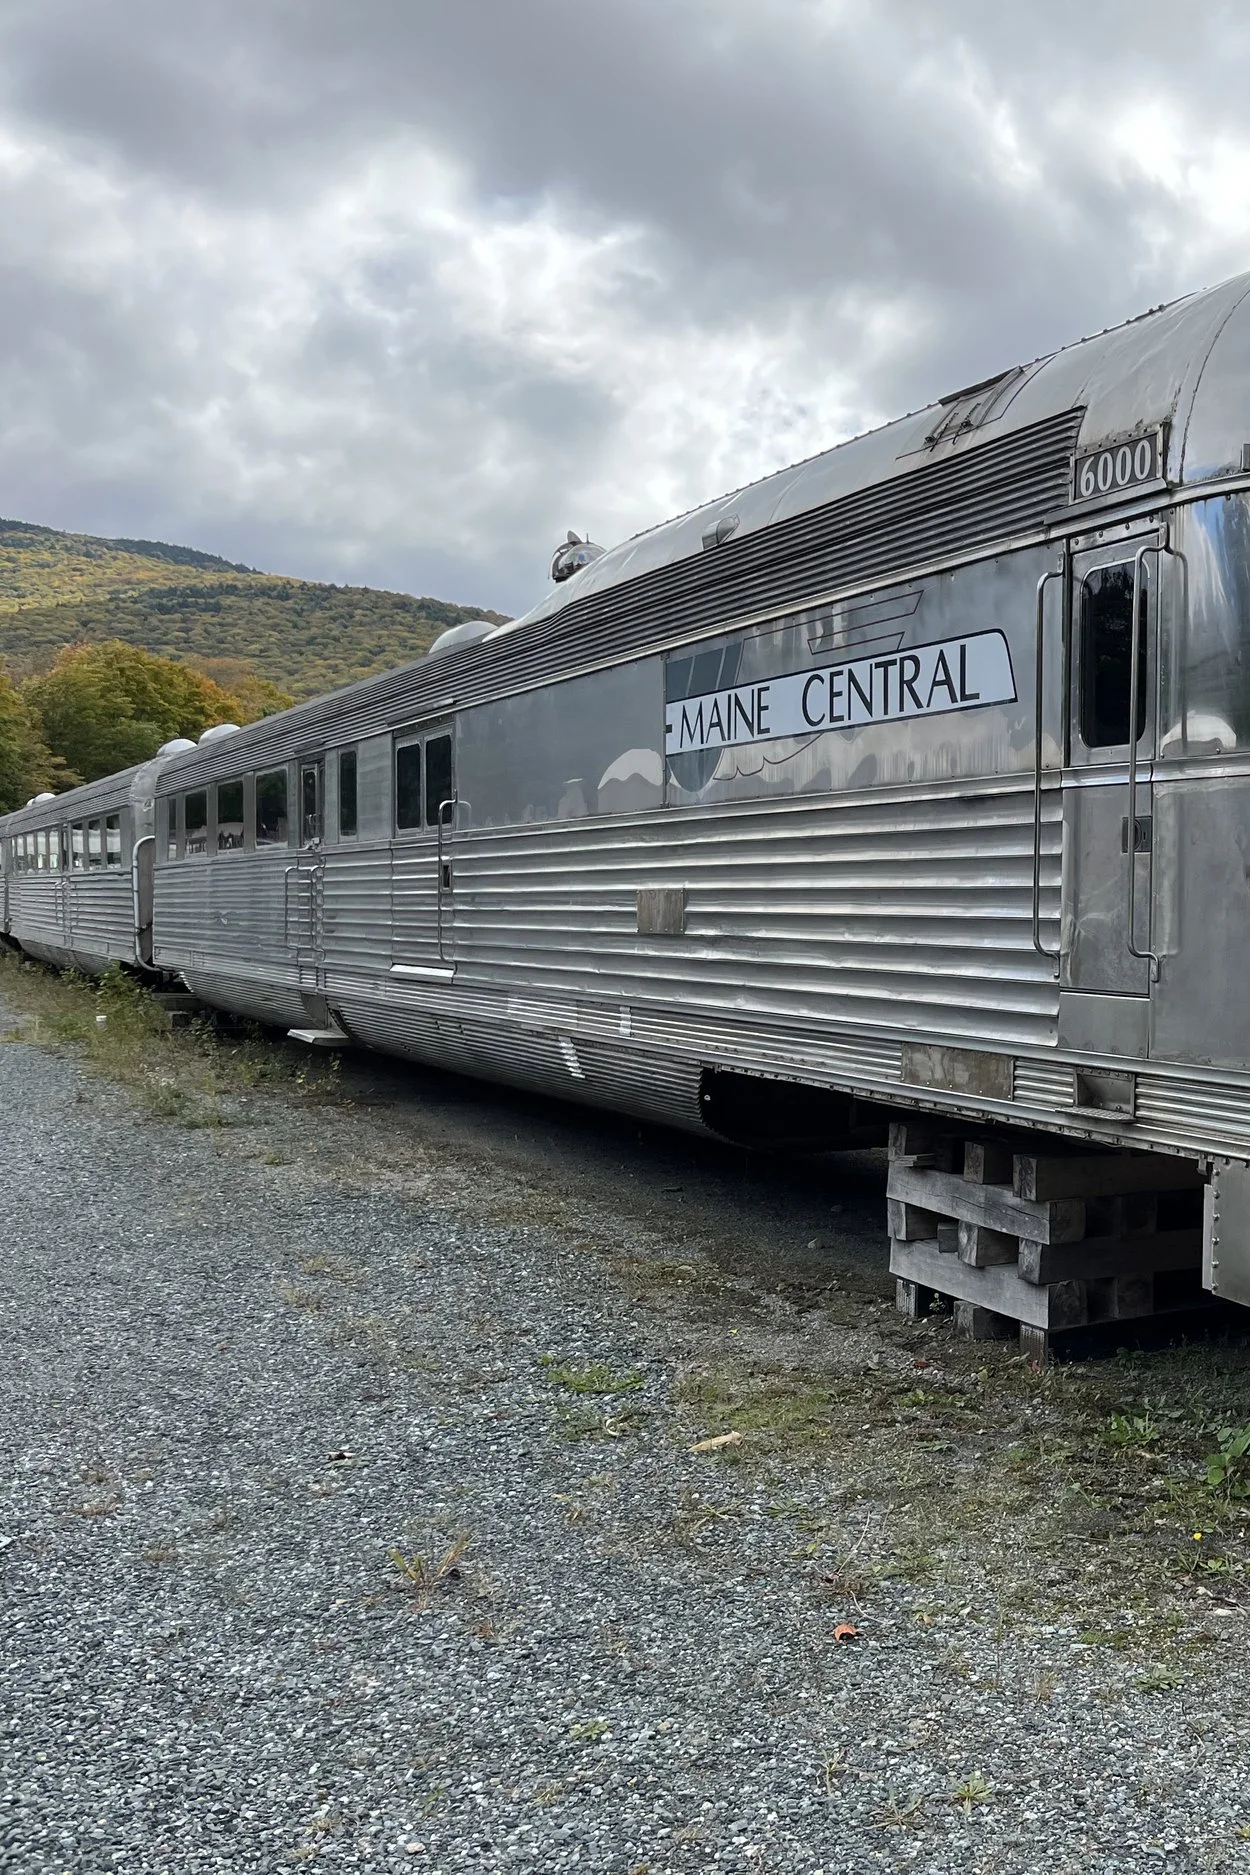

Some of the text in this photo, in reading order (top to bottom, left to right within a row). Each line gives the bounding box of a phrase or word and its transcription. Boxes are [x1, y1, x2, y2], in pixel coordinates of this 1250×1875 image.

[1080, 439, 1151, 497] 6000
[679, 644, 980, 748] MAINE CENTRAL
